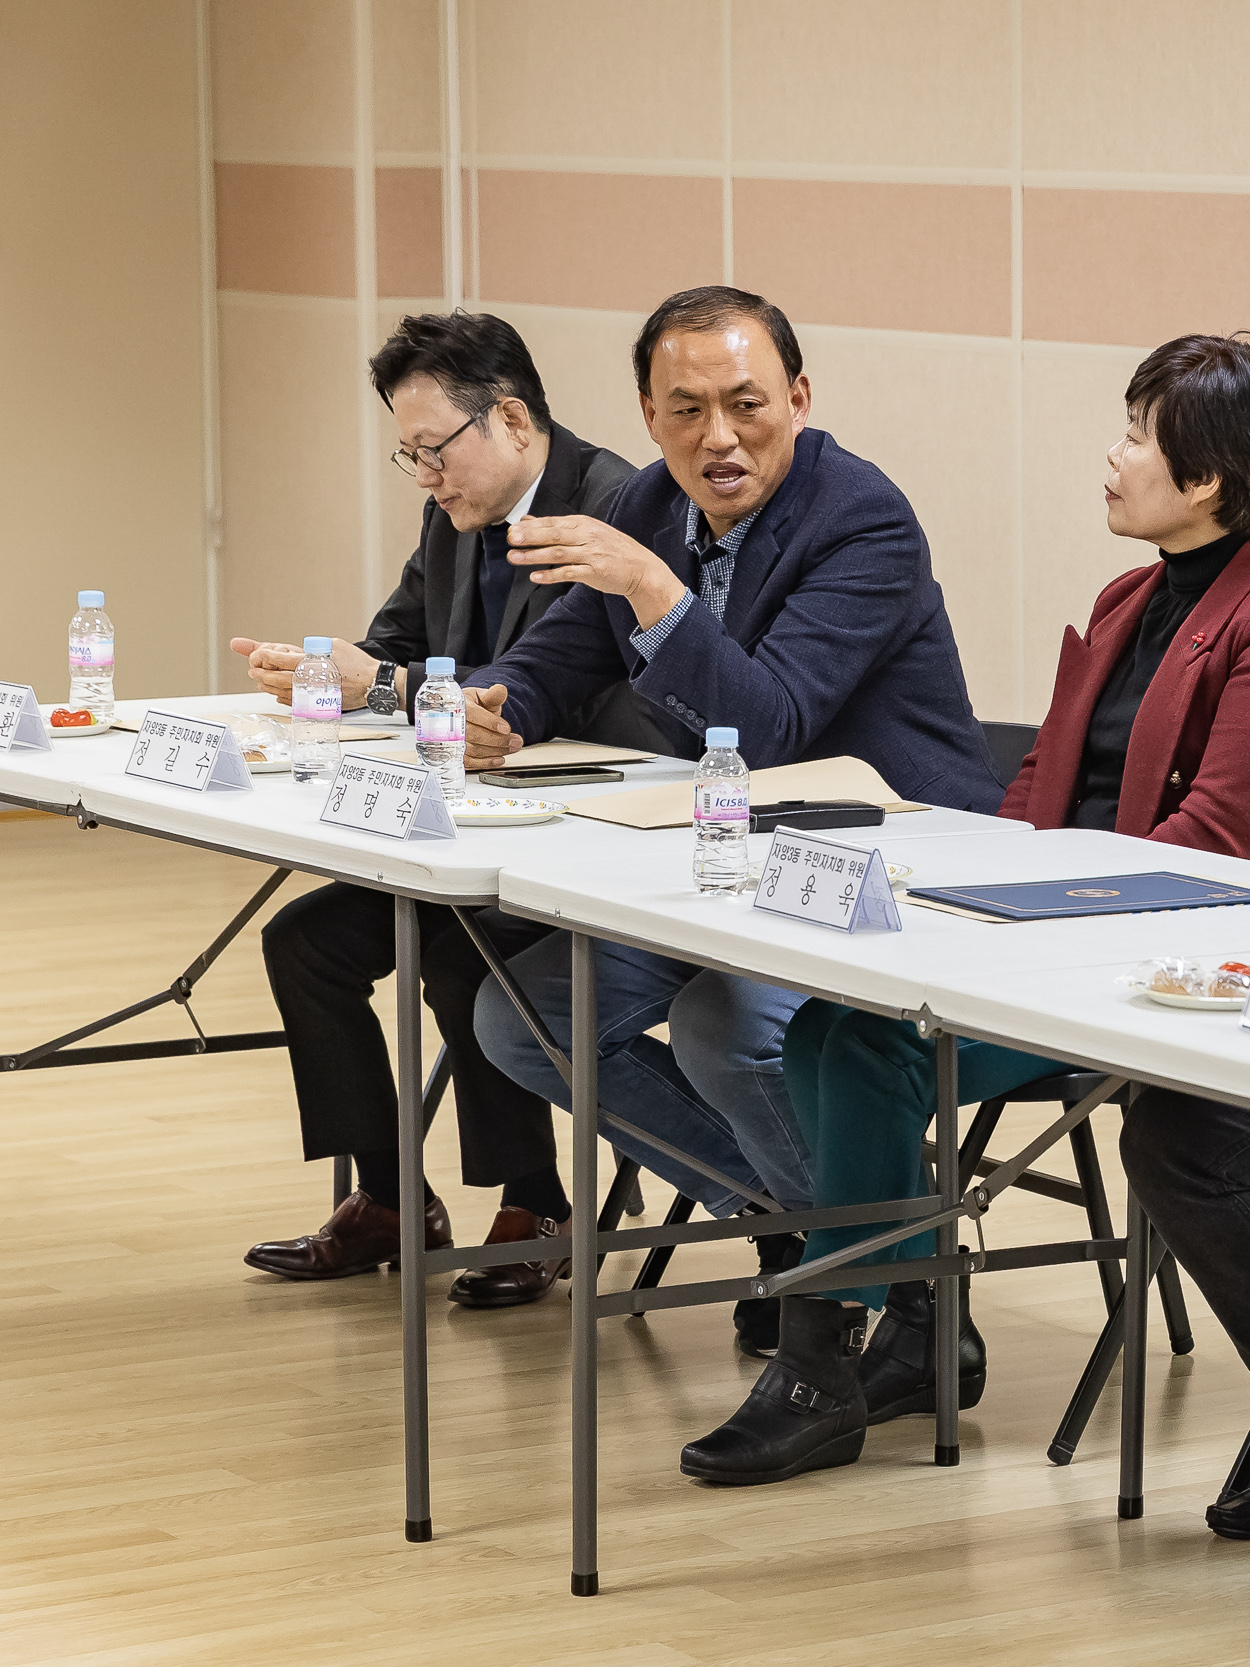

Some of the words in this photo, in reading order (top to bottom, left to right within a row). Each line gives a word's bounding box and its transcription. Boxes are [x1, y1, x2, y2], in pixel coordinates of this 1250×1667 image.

[10, 694, 24, 708] 위원
[169, 725, 204, 745] 주민자치회
[205, 733, 221, 749] 위원
[339, 764, 367, 782] 자양3동
[367, 769, 405, 790] 주민자치회
[406, 778, 424, 794] 위원
[771, 842, 802, 864] 자양3동
[803, 850, 846, 874] 주민자치회
[848, 860, 867, 879] 위원
